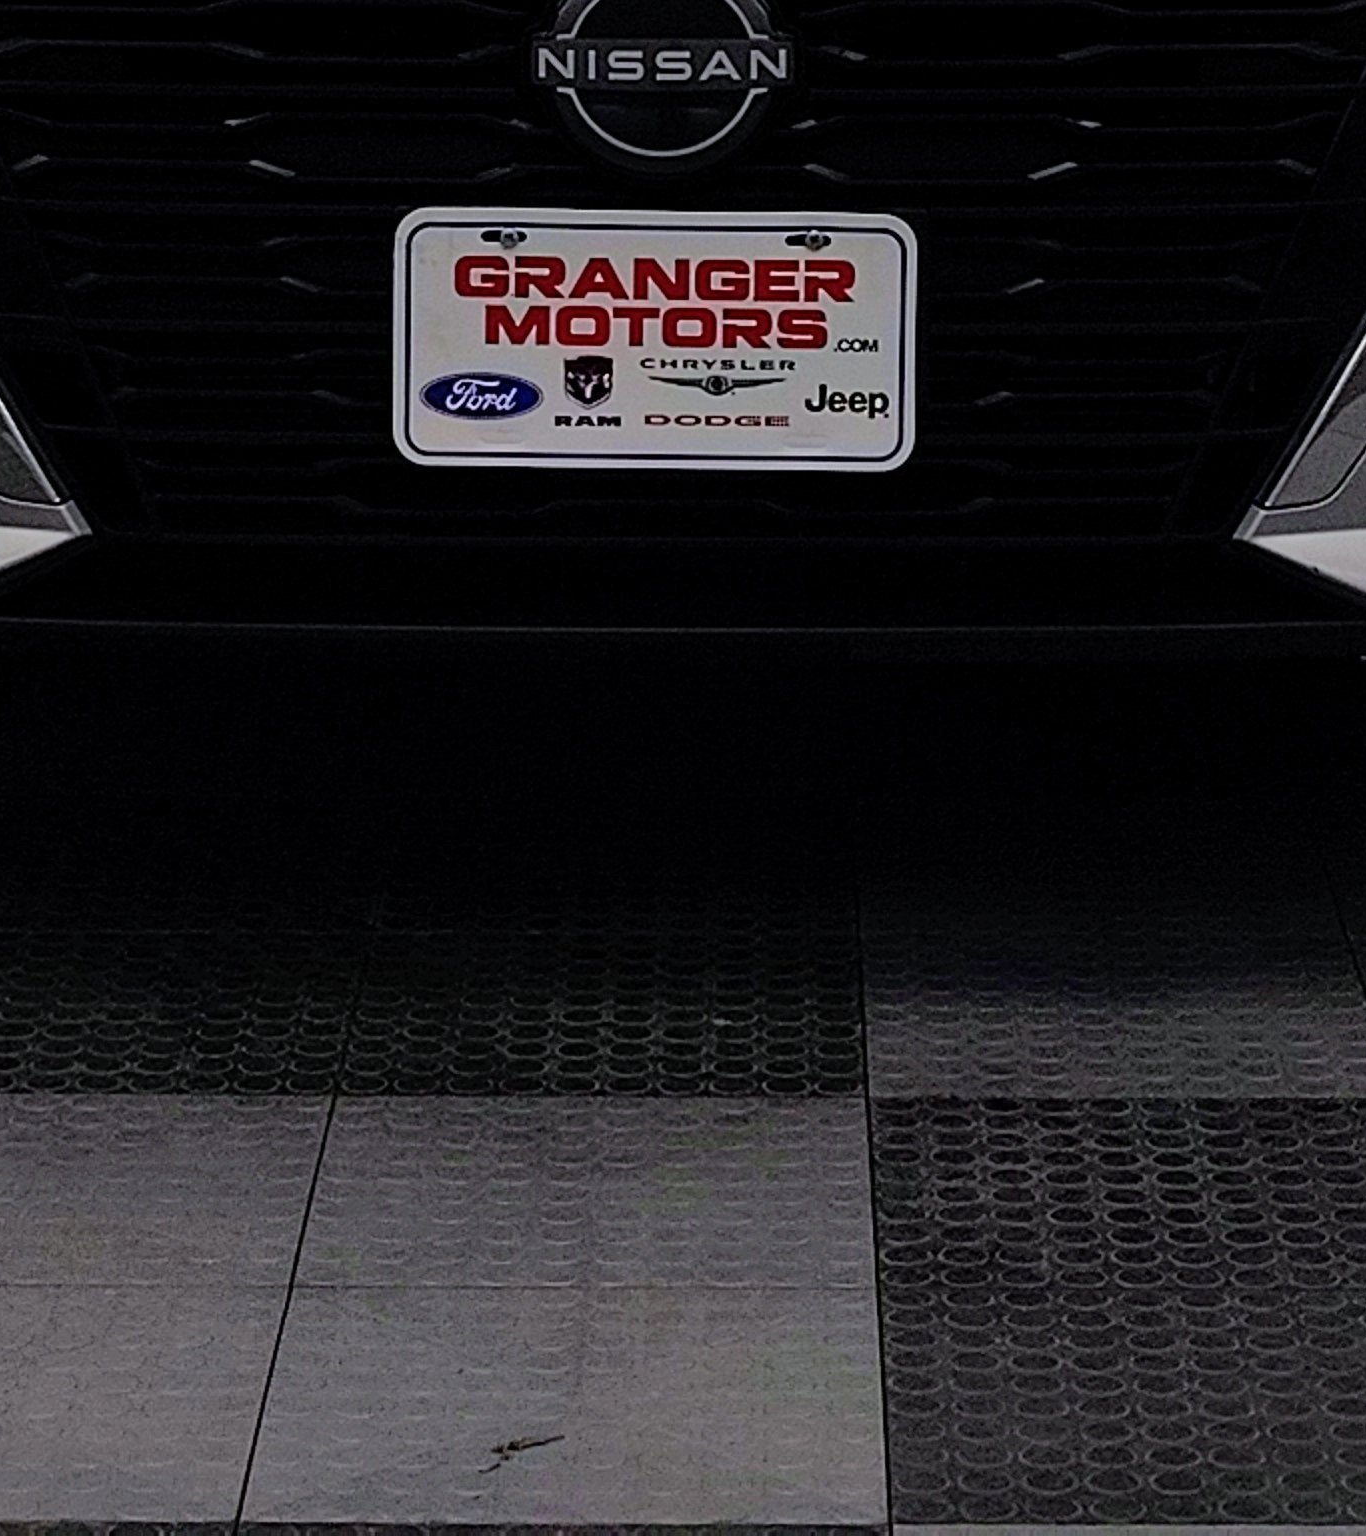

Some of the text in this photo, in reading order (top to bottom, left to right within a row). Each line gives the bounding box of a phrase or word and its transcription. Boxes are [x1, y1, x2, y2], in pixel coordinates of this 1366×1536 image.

[538, 47, 787, 81] NISSAN
[454, 255, 856, 303] GRANGER
[485, 305, 828, 350] MOTORS
[640, 358, 796, 372] CHRYSLER
[445, 380, 518, 412] Ford
[804, 384, 889, 419] Jeep
[555, 416, 622, 428] RAM
[644, 415, 790, 428] DODGE
